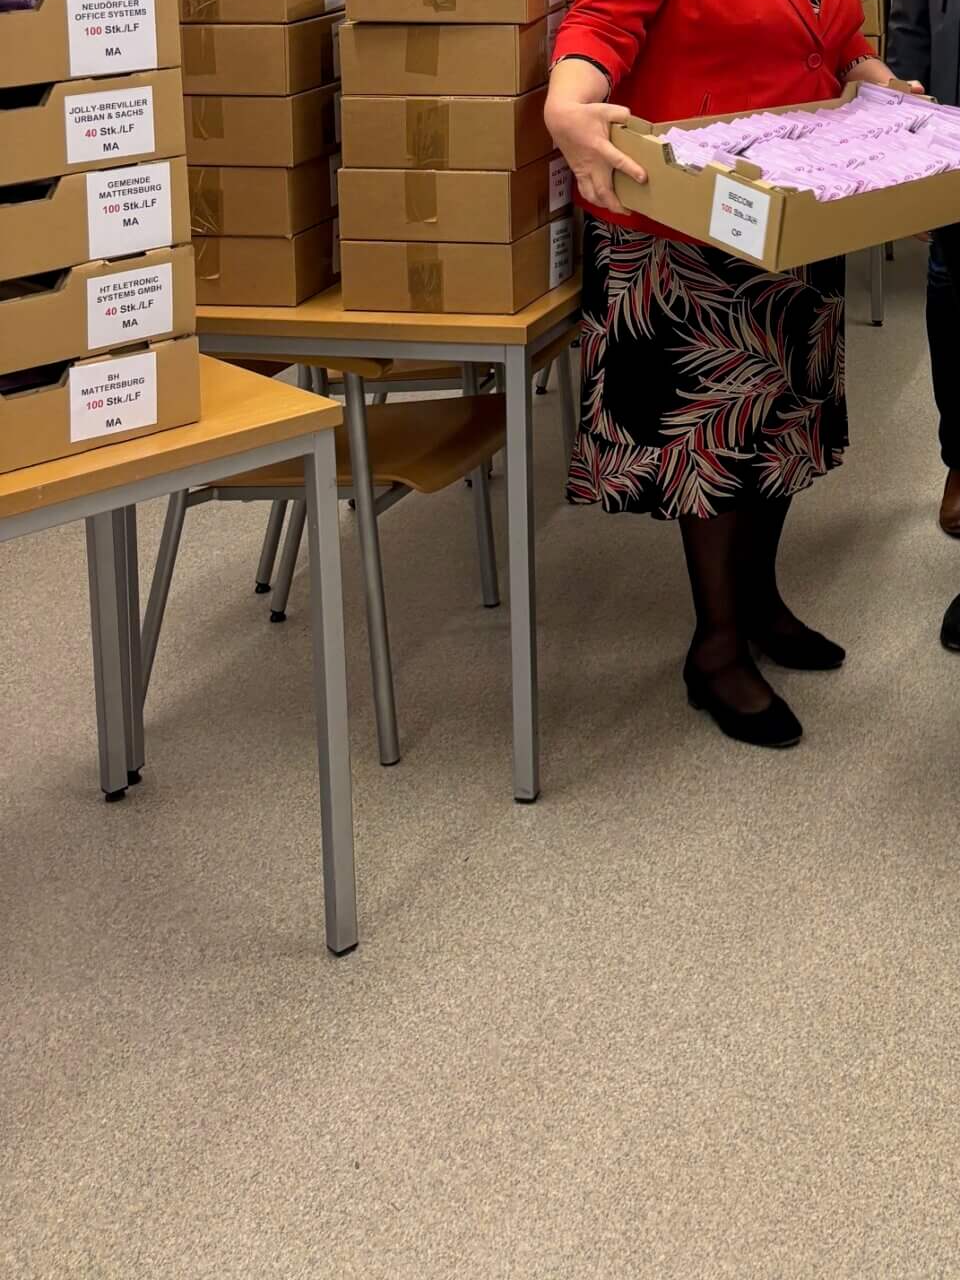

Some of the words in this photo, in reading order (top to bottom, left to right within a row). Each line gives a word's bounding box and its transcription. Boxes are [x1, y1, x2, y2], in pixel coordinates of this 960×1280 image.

[82, 0, 139, 11] NEUDÖRFLER
[75, 12, 106, 21] OFFICE
[107, 8, 147, 18] SYSTEMS
[85, 26, 102, 36] 100
[105, 23, 140, 34] Stk./LF
[105, 47, 122, 56] MA
[69, 98, 148, 115] JOLLY-BREVILLIER
[74, 113, 105, 123] URBAN
[115, 108, 144, 118] SACHS
[85, 128, 97, 138] 40
[100, 123, 134, 136] Stk./LF
[103, 142, 120, 152] MA
[107, 176, 151, 189] GEMEINDE
[99, 184, 162, 199] MATTERSBURG
[102, 204, 120, 214] 100
[123, 198, 157, 211] Stk./LF
[122, 217, 139, 227] MA
[99, 285, 111, 294] HT
[112, 276, 159, 291] ELETRONIC
[96, 290, 136, 303] SYSTEMS
[137, 285, 162, 295] GMBH
[105, 307, 118, 316] 40
[119, 299, 154, 313] Stk./LF
[122, 318, 138, 328] MA
[107, 373, 120, 381] BH
[81, 377, 145, 396] MATTERSBURG
[86, 400, 104, 410] 100
[106, 391, 141, 406] Stk./LF
[105, 417, 122, 427] MA
